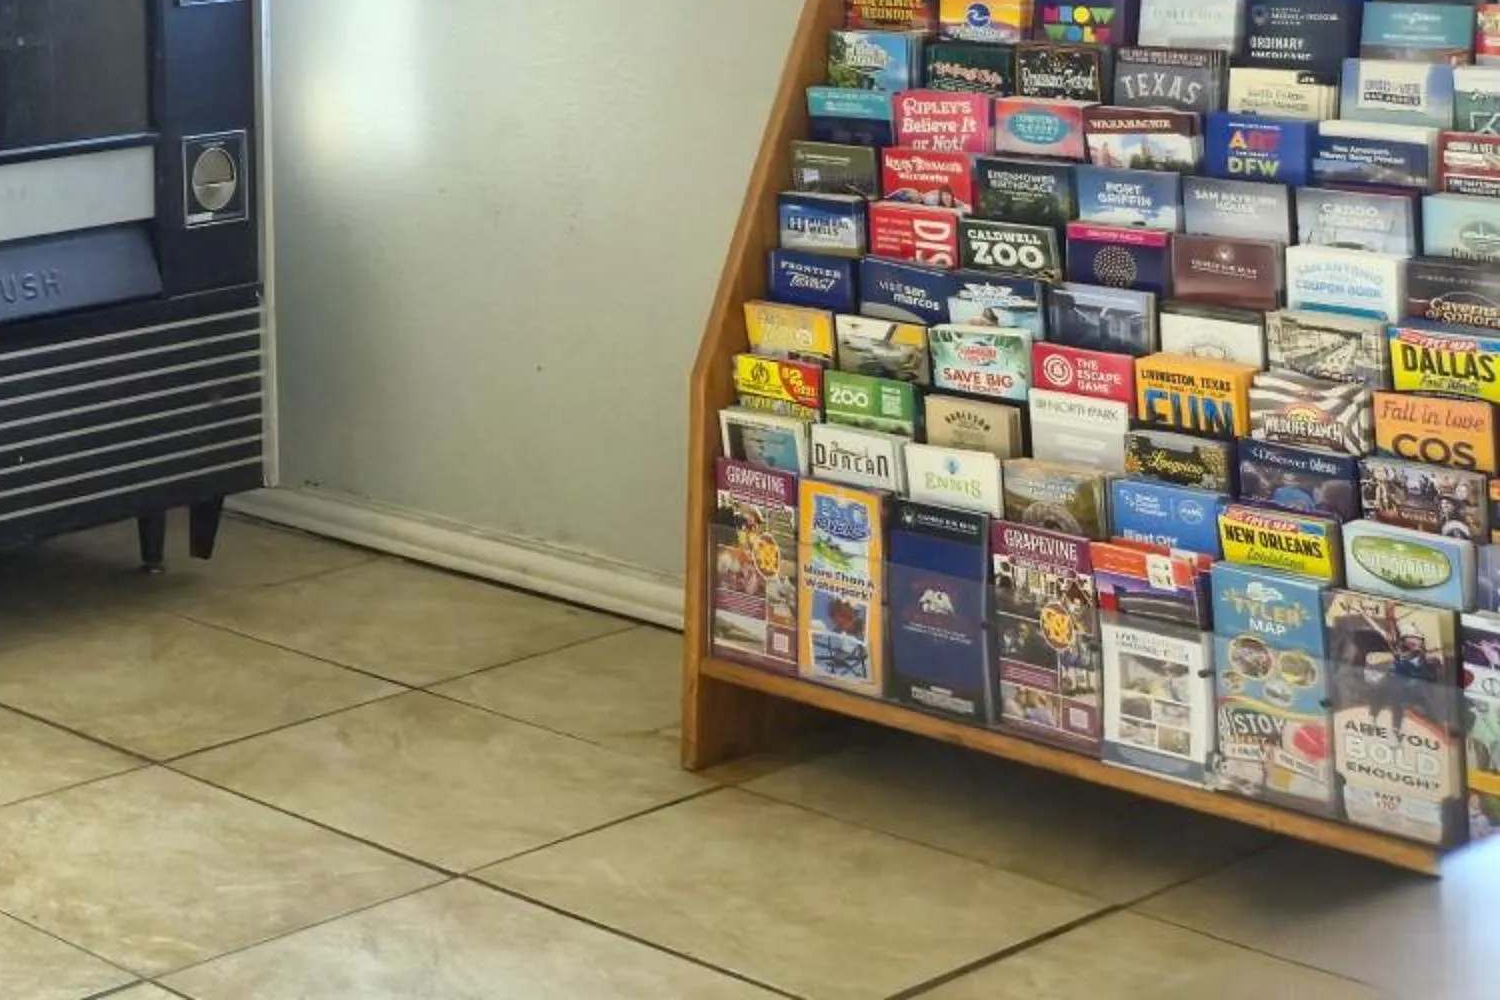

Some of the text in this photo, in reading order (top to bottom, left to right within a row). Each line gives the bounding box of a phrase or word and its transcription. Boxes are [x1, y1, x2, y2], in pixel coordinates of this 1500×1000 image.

[1121, 71, 1202, 105] TEXAS
[901, 97, 973, 117] RIPLEY'S
[901, 117, 978, 134] Believe It
[912, 136, 966, 152] or Not!
[1227, 156, 1280, 177] DFW
[1105, 180, 1143, 194] FORT
[1097, 192, 1152, 208] GRIFFIN
[967, 228, 1042, 244] CALDWELL
[970, 243, 1046, 269] ZOO
[779, 259, 842, 278] FRONTIER
[893, 291, 941, 312] marcos
[1429, 296, 1499, 316] Caverns
[1076, 357, 1098, 371] THE
[1400, 342, 1496, 384] DALLAS
[942, 367, 1014, 388] SAVE BIG
[1076, 368, 1122, 384] ESCAPE
[1077, 379, 1109, 394] GAME
[1199, 375, 1232, 392] TEXAS
[1143, 387, 1234, 441] FUN
[1381, 399, 1486, 431] Fall in love
[814, 440, 890, 479] DUNCAN
[1391, 432, 1479, 470] COS
[725, 464, 786, 494] GRAPEVINE
[924, 470, 983, 500] ENNIS
[1003, 527, 1078, 562] GRAPEVINE
[1224, 525, 1323, 559] NEW ORLEANS
[1248, 616, 1288, 637] MAP
[1344, 719, 1441, 755] ARE YOU
[1346, 735, 1444, 779] BOLD
[1345, 761, 1441, 790] ENOUGH?
